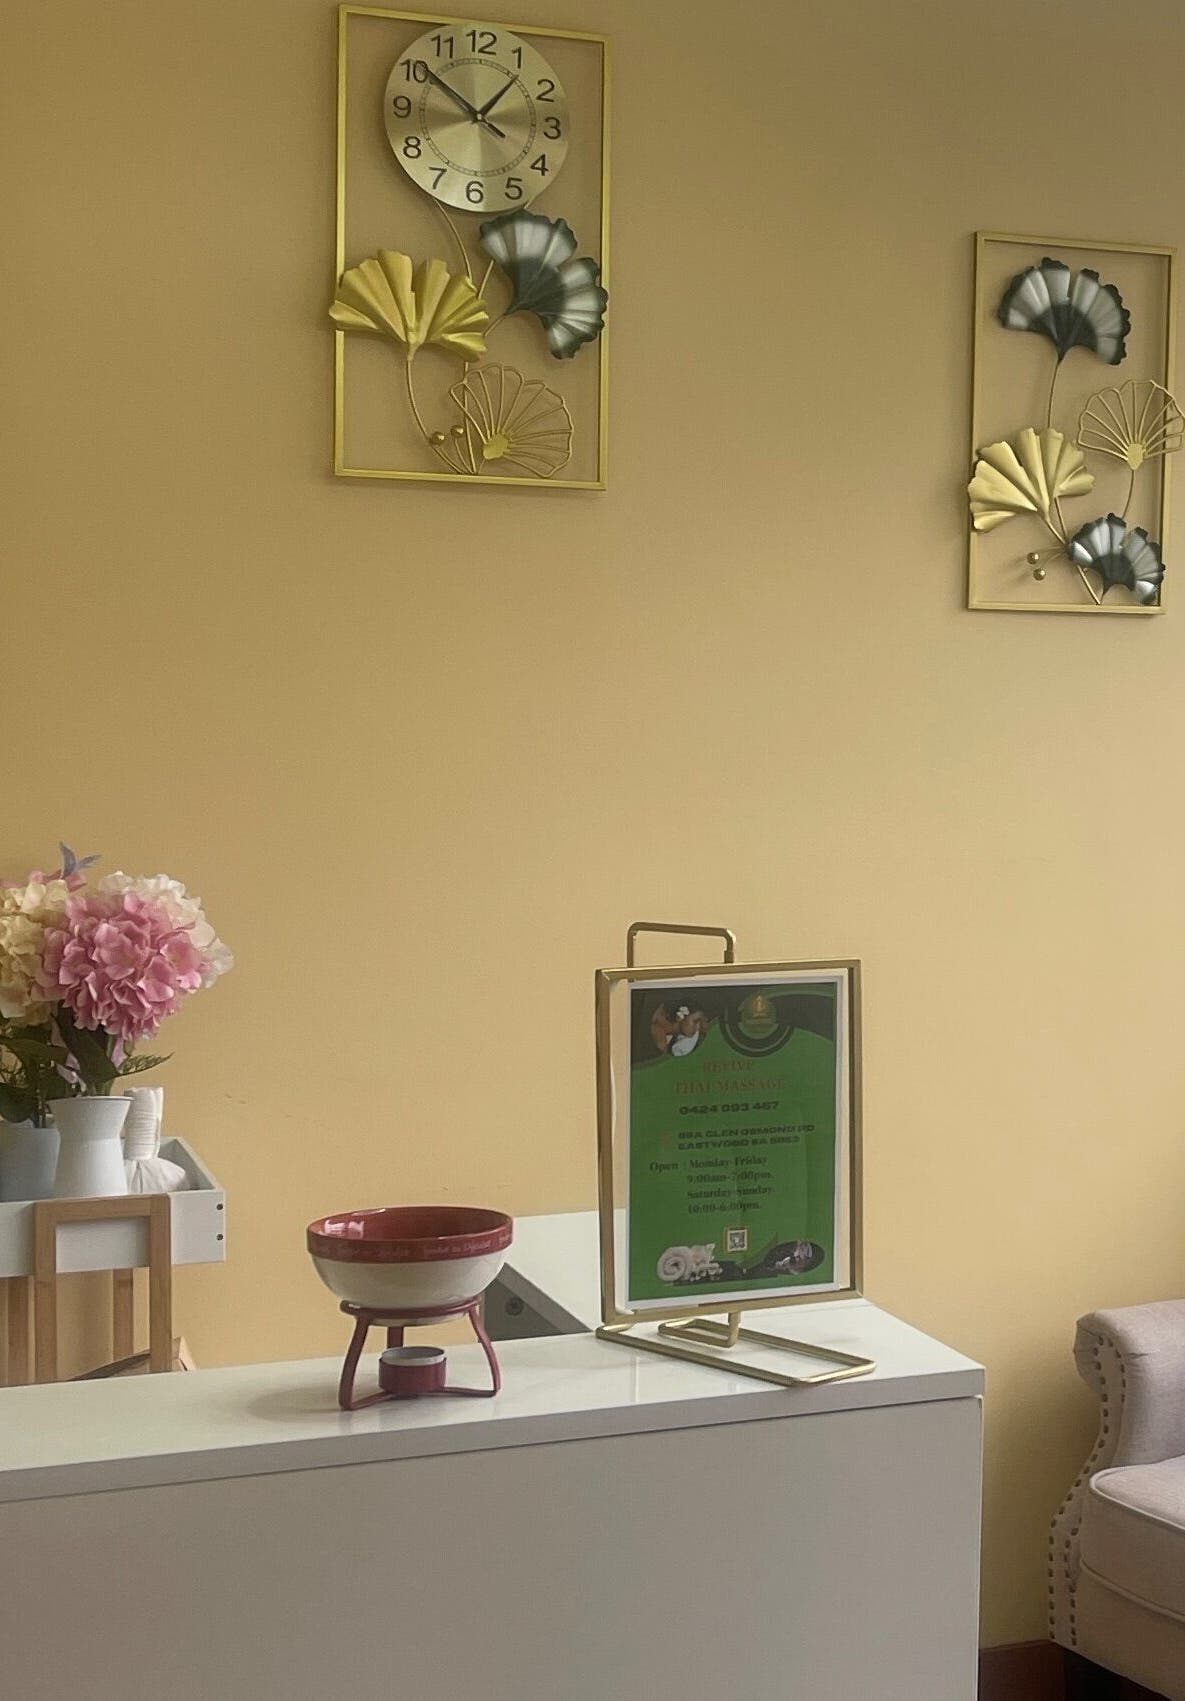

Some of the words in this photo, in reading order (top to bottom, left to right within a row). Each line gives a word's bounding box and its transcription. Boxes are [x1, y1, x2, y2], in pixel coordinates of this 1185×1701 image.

[430, 34, 455, 60] 11
[466, 29, 498, 56] 12
[511, 46, 522, 69] 1
[400, 59, 430, 84] 10
[536, 78, 556, 103] 2
[392, 95, 412, 119] 9
[543, 116, 562, 140] 3
[402, 136, 422, 160] 8
[530, 153, 550, 177] 4
[428, 166, 448, 190] 7
[504, 177, 523, 201] 5
[465, 180, 485, 204] 6
